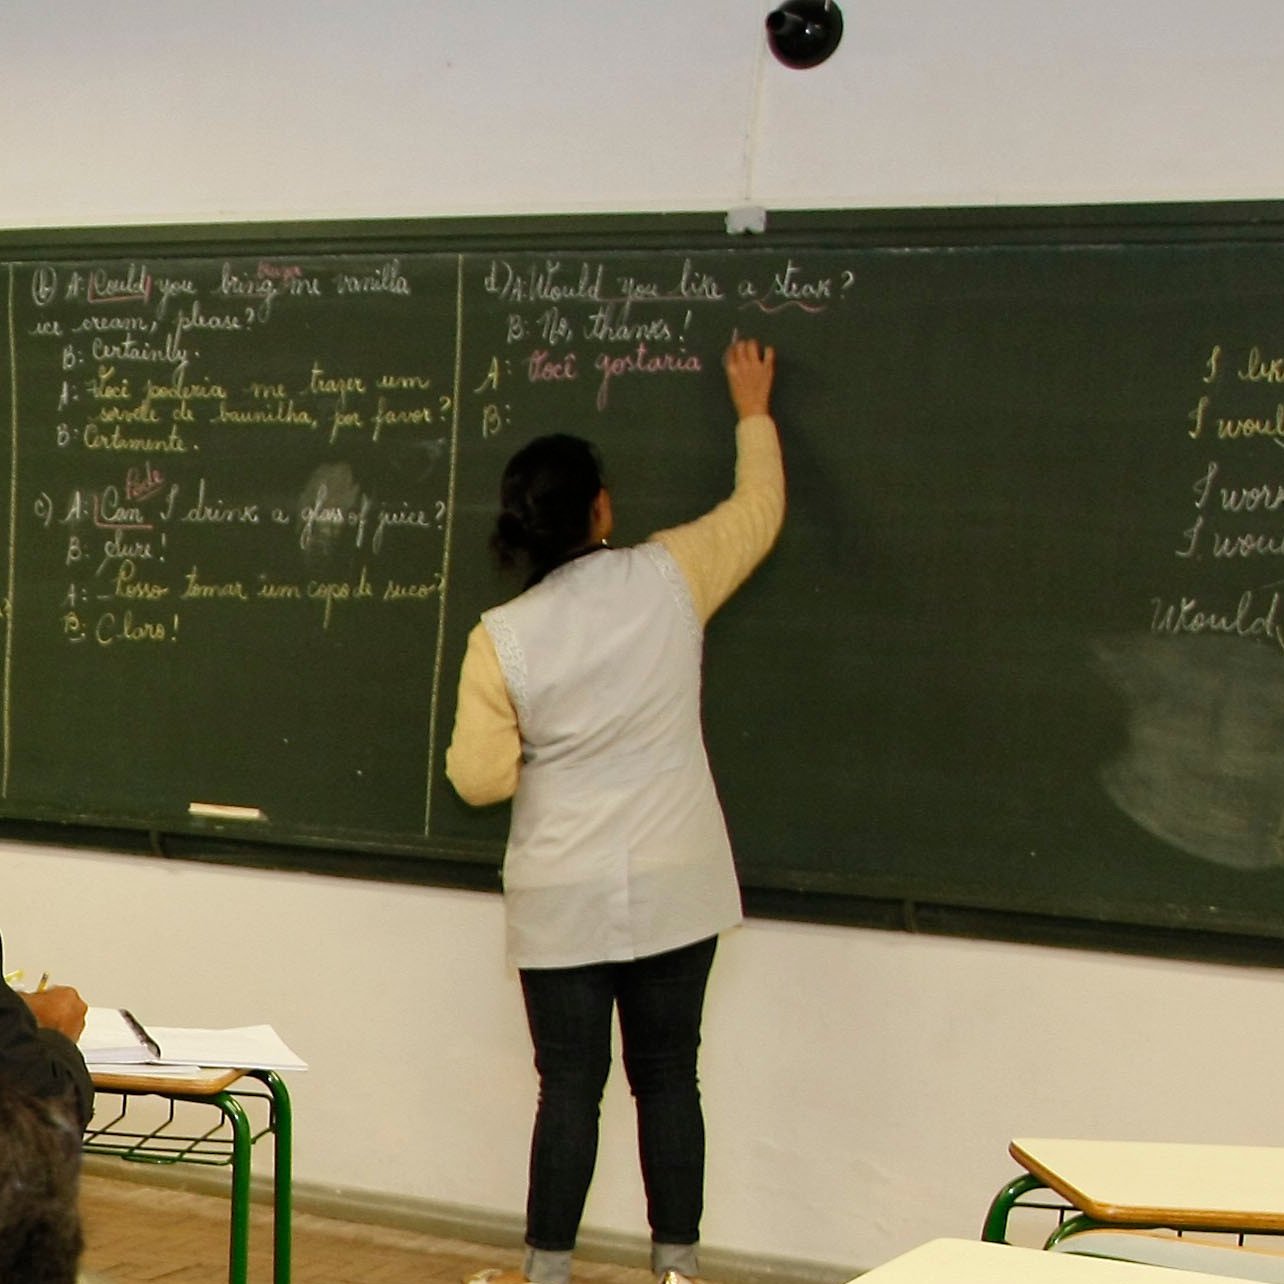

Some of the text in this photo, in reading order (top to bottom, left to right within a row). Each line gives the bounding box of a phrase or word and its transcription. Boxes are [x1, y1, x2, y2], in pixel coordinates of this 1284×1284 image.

[94, 263, 148, 296] Could
[154, 278, 198, 322] you
[288, 277, 321, 296] me
[530, 260, 604, 301] Would
[669, 258, 723, 299] like
[738, 278, 758, 296] a
[32, 320, 64, 338] ice
[376, 374, 430, 390] um
[594, 343, 703, 412] gostaria
[101, 485, 144, 523] Can
[184, 478, 259, 522] drink
[271, 507, 289, 525] a
